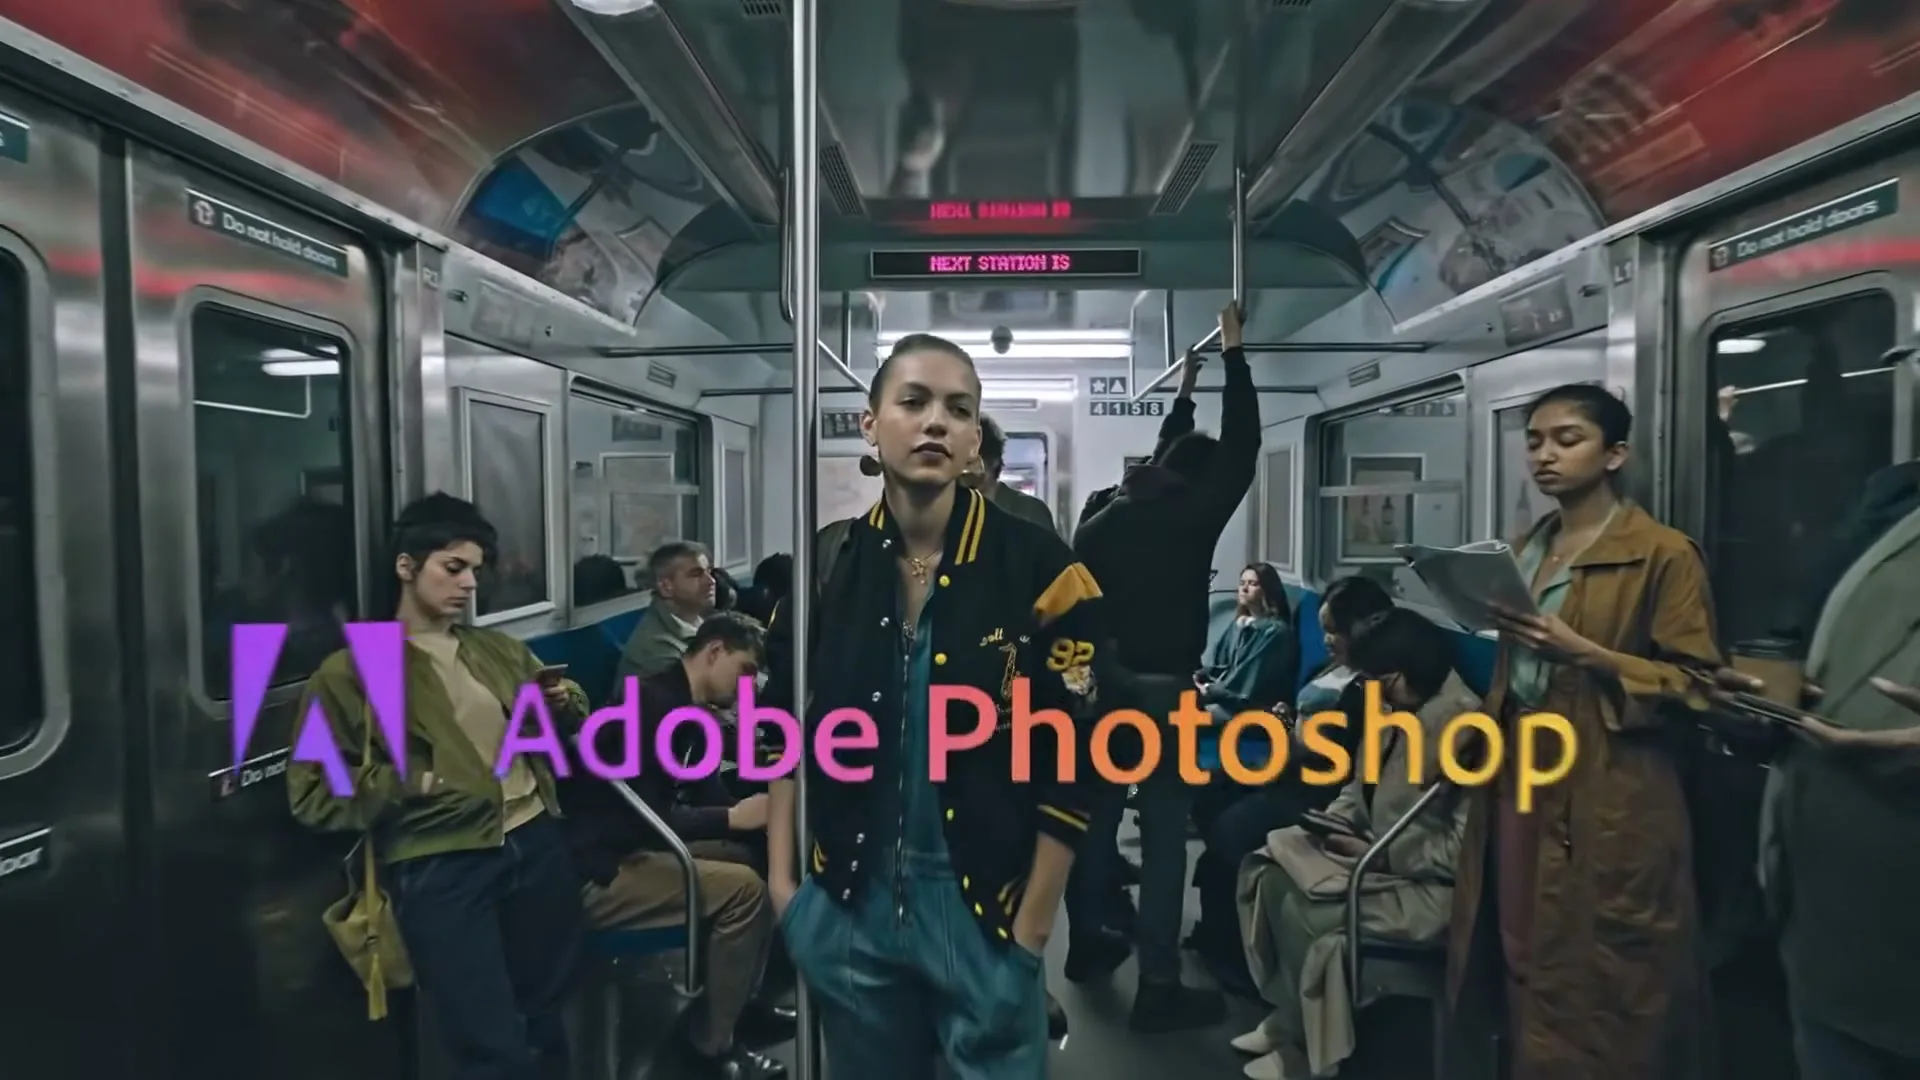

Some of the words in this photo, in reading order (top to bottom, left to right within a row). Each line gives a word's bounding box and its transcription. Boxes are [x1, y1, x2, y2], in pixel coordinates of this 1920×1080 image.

[222, 211, 246, 235] Do
[246, 224, 271, 245] not
[271, 231, 302, 256] hold
[1737, 240, 1758, 257] Do
[1760, 230, 1786, 248] not
[1786, 215, 1823, 241] hold
[1825, 199, 1880, 229] doors
[930, 255, 972, 272] NEXT
[977, 254, 1047, 272] STATION
[1051, 254, 1071, 271] IS
[1092, 402, 1161, 416] 4158
[1046, 637, 1096, 672] 92
[240, 768, 264, 788] Do
[0, 846, 44, 877] oor
